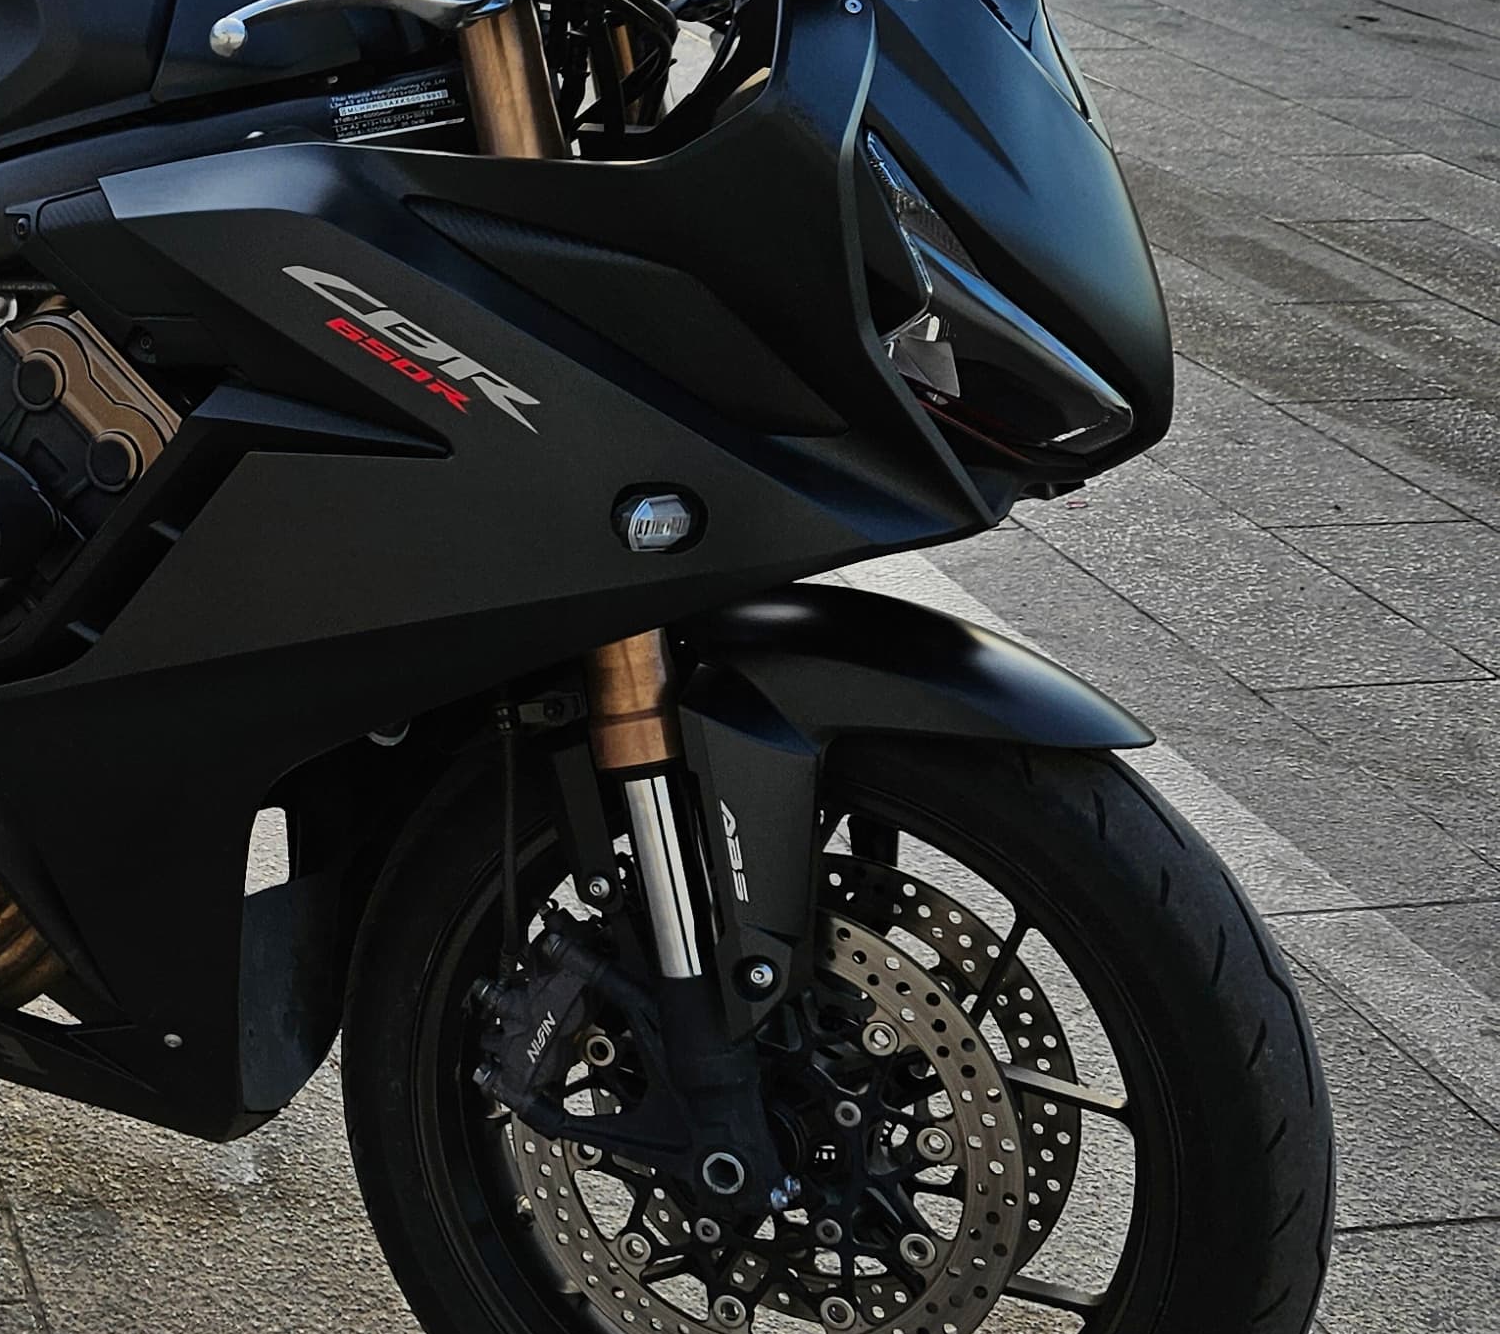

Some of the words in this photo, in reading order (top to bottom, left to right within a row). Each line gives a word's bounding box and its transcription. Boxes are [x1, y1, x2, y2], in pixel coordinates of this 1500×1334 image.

[281, 265, 541, 436] CBR
[324, 317, 471, 415] 650R
[720, 798, 749, 903] ABS
